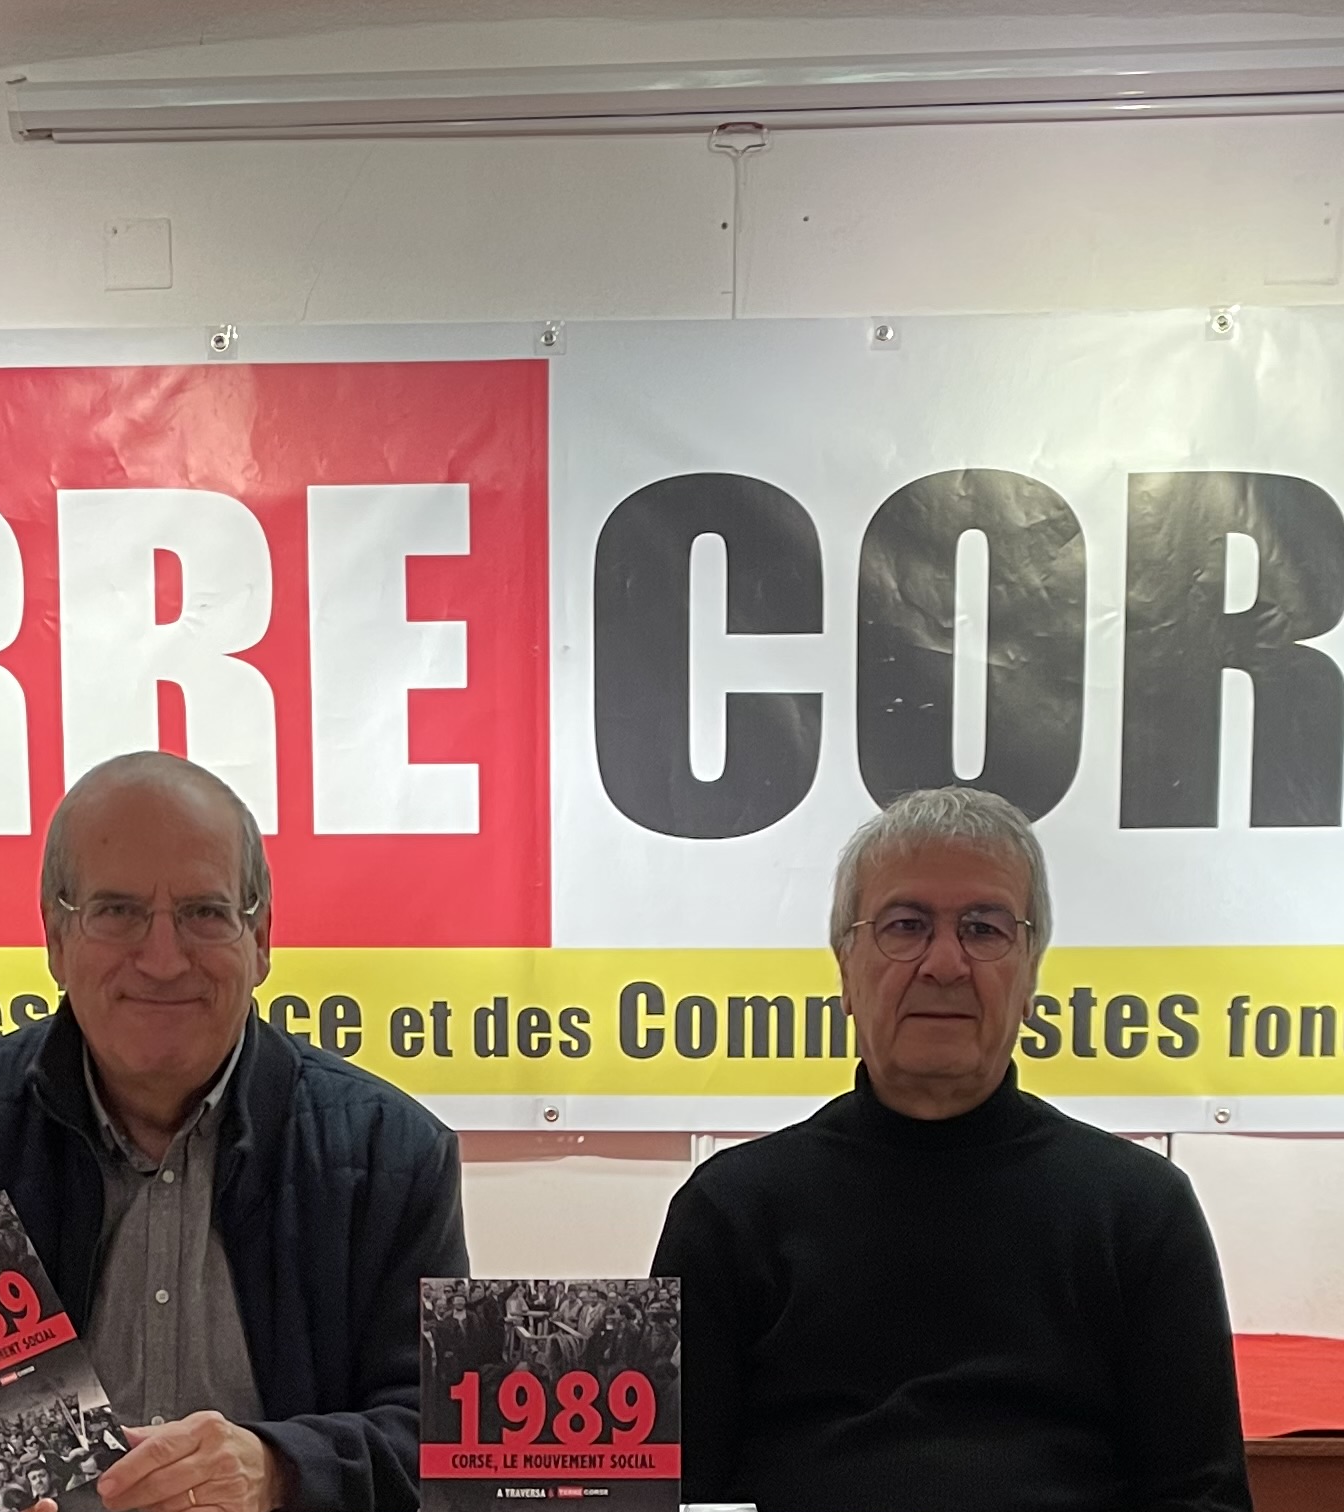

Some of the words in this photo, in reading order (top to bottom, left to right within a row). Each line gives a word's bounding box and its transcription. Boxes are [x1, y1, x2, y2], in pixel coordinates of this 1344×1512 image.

[389, 1001, 453, 1058] et
[474, 996, 592, 1059] des
[22, 1328, 57, 1350] SOCIAL
[450, 1370, 656, 1446] 1989
[451, 1453, 499, 1472] CORSE,
[503, 1454, 518, 1469] LE
[523, 1454, 605, 1469] MOUVEMENT
[609, 1454, 656, 1469] SOCIAL
[505, 1488, 546, 1498] TRAVERSA
